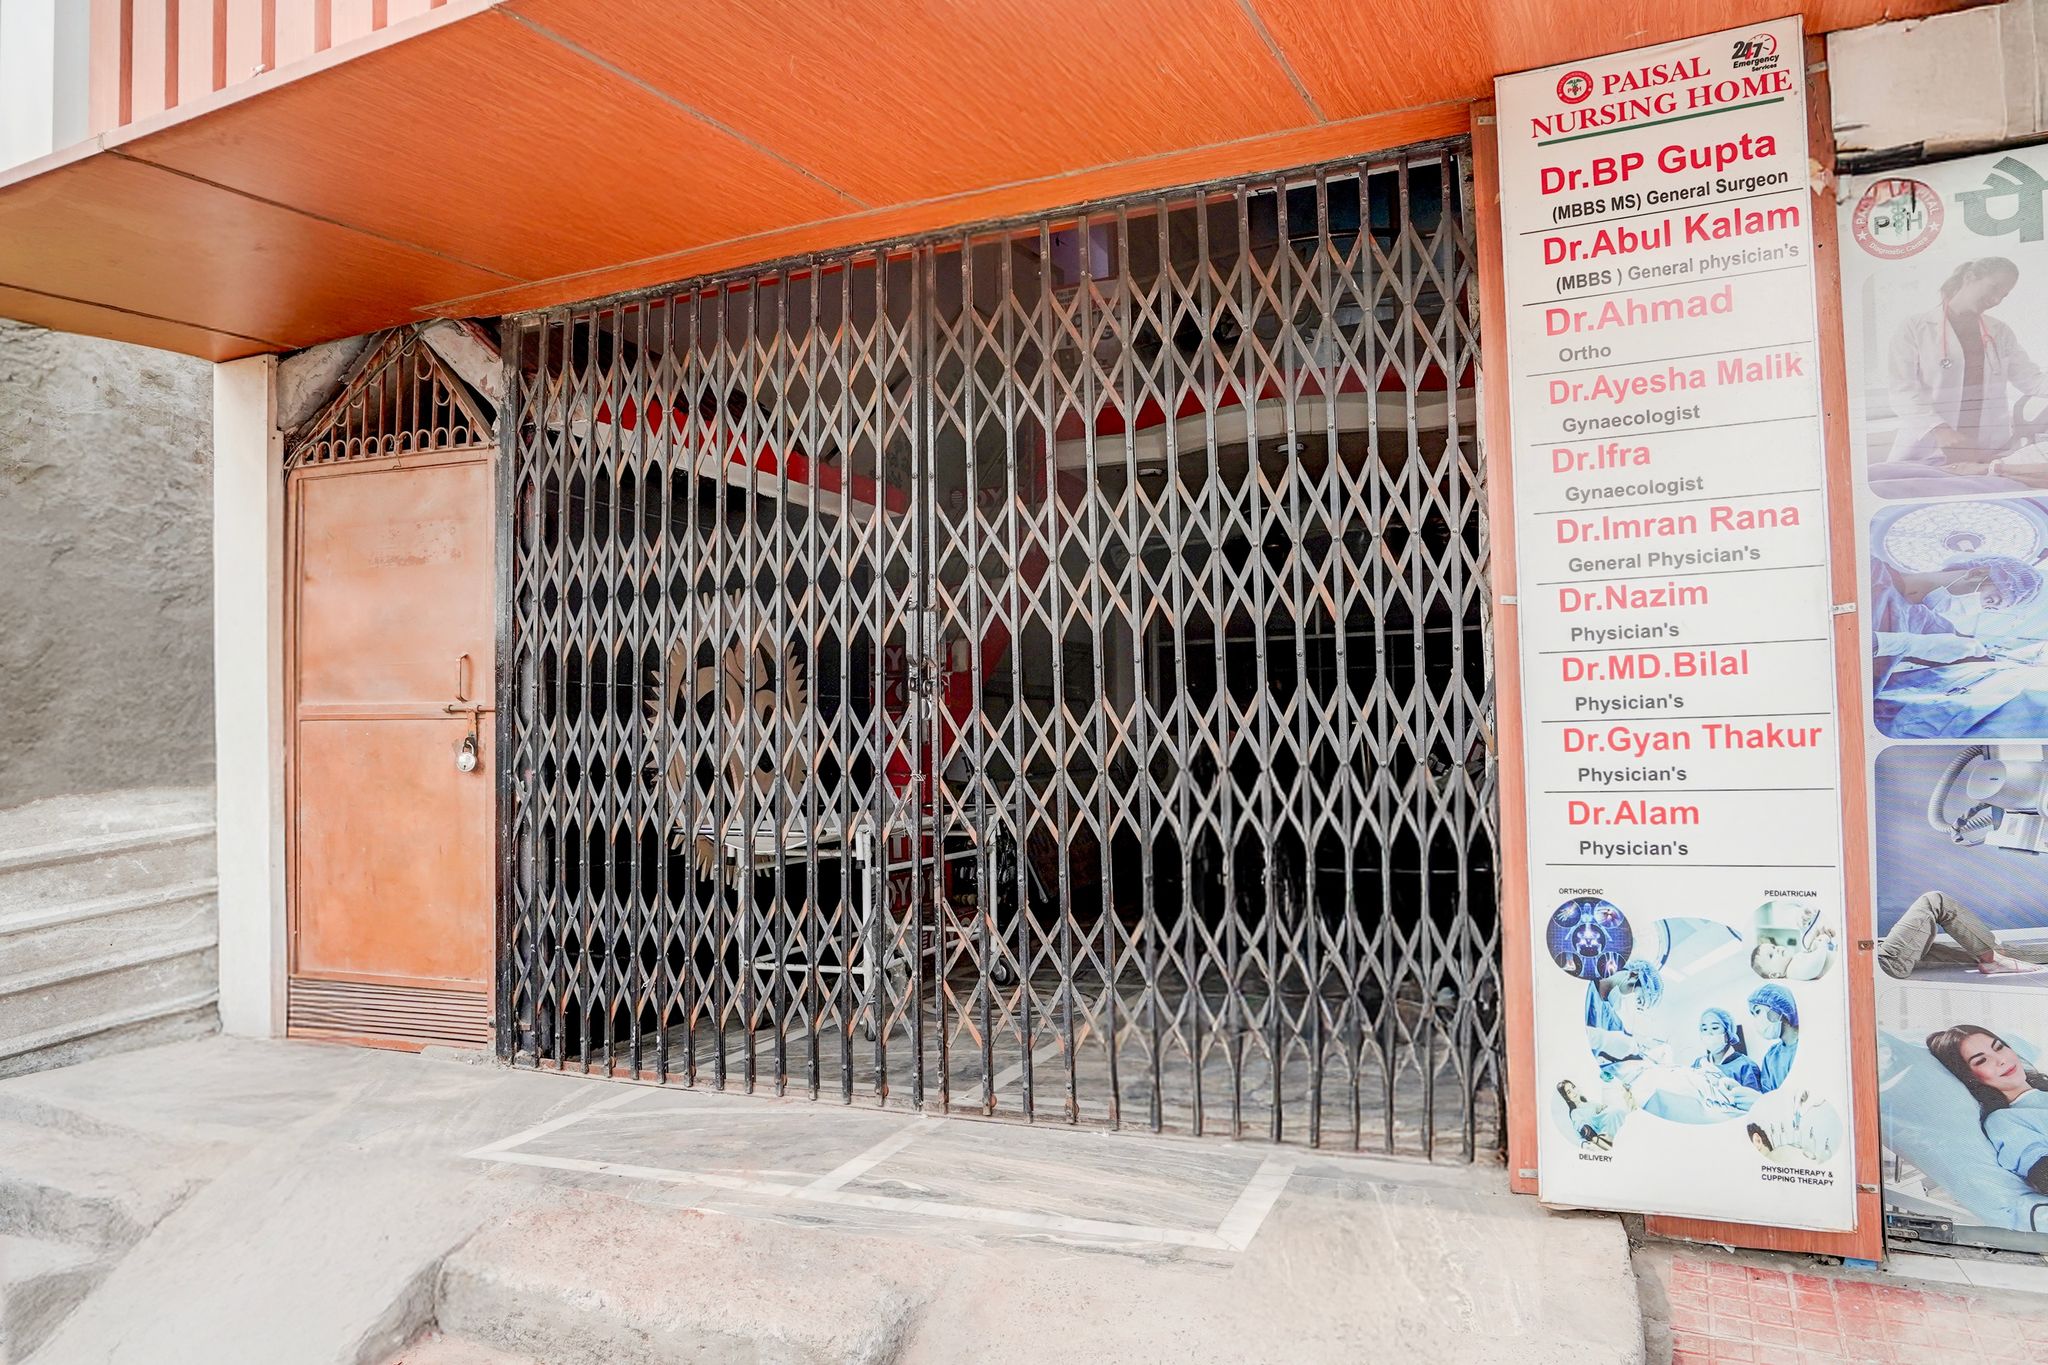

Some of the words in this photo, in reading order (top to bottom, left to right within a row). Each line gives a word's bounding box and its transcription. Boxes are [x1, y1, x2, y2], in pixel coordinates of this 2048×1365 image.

[1733, 55, 1779, 68] Emergency
[1752, 64, 1777, 72] Services
[1602, 57, 1711, 96] PAISAL
[1531, 92, 1677, 138] NURSING
[1687, 69, 1792, 109] HOME
[1541, 152, 1644, 195] Dr.BP
[1657, 133, 1776, 174] Gupta
[1552, 199, 1605, 224] (MBBS
[1611, 193, 1642, 212] MS)
[1646, 182, 1710, 205] General
[1716, 171, 1788, 193] Surgeon
[1543, 219, 1670, 265] Dr.Abul
[1685, 205, 1800, 243] Kalam
[1628, 258, 1693, 280] General
[1700, 243, 1799, 273] physician's
[1545, 284, 1733, 336] Dr.Ahmad
[1559, 345, 1611, 362] Ortho
[1550, 367, 1706, 404] Dr.Ayesha
[1717, 352, 1804, 385] Malik
[1562, 404, 1700, 434] Gynaecologist
[1552, 443, 1651, 473] Dr.Ifra
[1565, 476, 1704, 503] Gynaecologist
[1557, 514, 1697, 544] Dr.Imran
[1710, 505, 1800, 532] Rana
[1568, 554, 1641, 573] General
[1648, 546, 1760, 569] Physician's
[1559, 581, 1708, 613] Dr.Nazim
[1571, 623, 1679, 644] Physician's
[1562, 649, 1748, 682] Dr.MD.Bilal
[1575, 694, 1684, 714] Physician's
[1563, 727, 1691, 757] Dr.Gyan
[1702, 722, 1823, 749] Thakur
[1578, 766, 1687, 785] Physician's
[1568, 800, 1699, 825] Dr.Alam
[1579, 841, 1688, 859] Physician's
[1558, 887, 1604, 895] ORTHOPEDIC
[1764, 889, 1817, 898] PEDIATRICIAN
[1578, 1153, 1613, 1162] DELIVERY
[1761, 1165, 1825, 1177] PHYSIOTHERAPY
[1761, 1173, 1796, 1183] CUPPING
[1797, 1176, 1834, 1186] THERAPY
